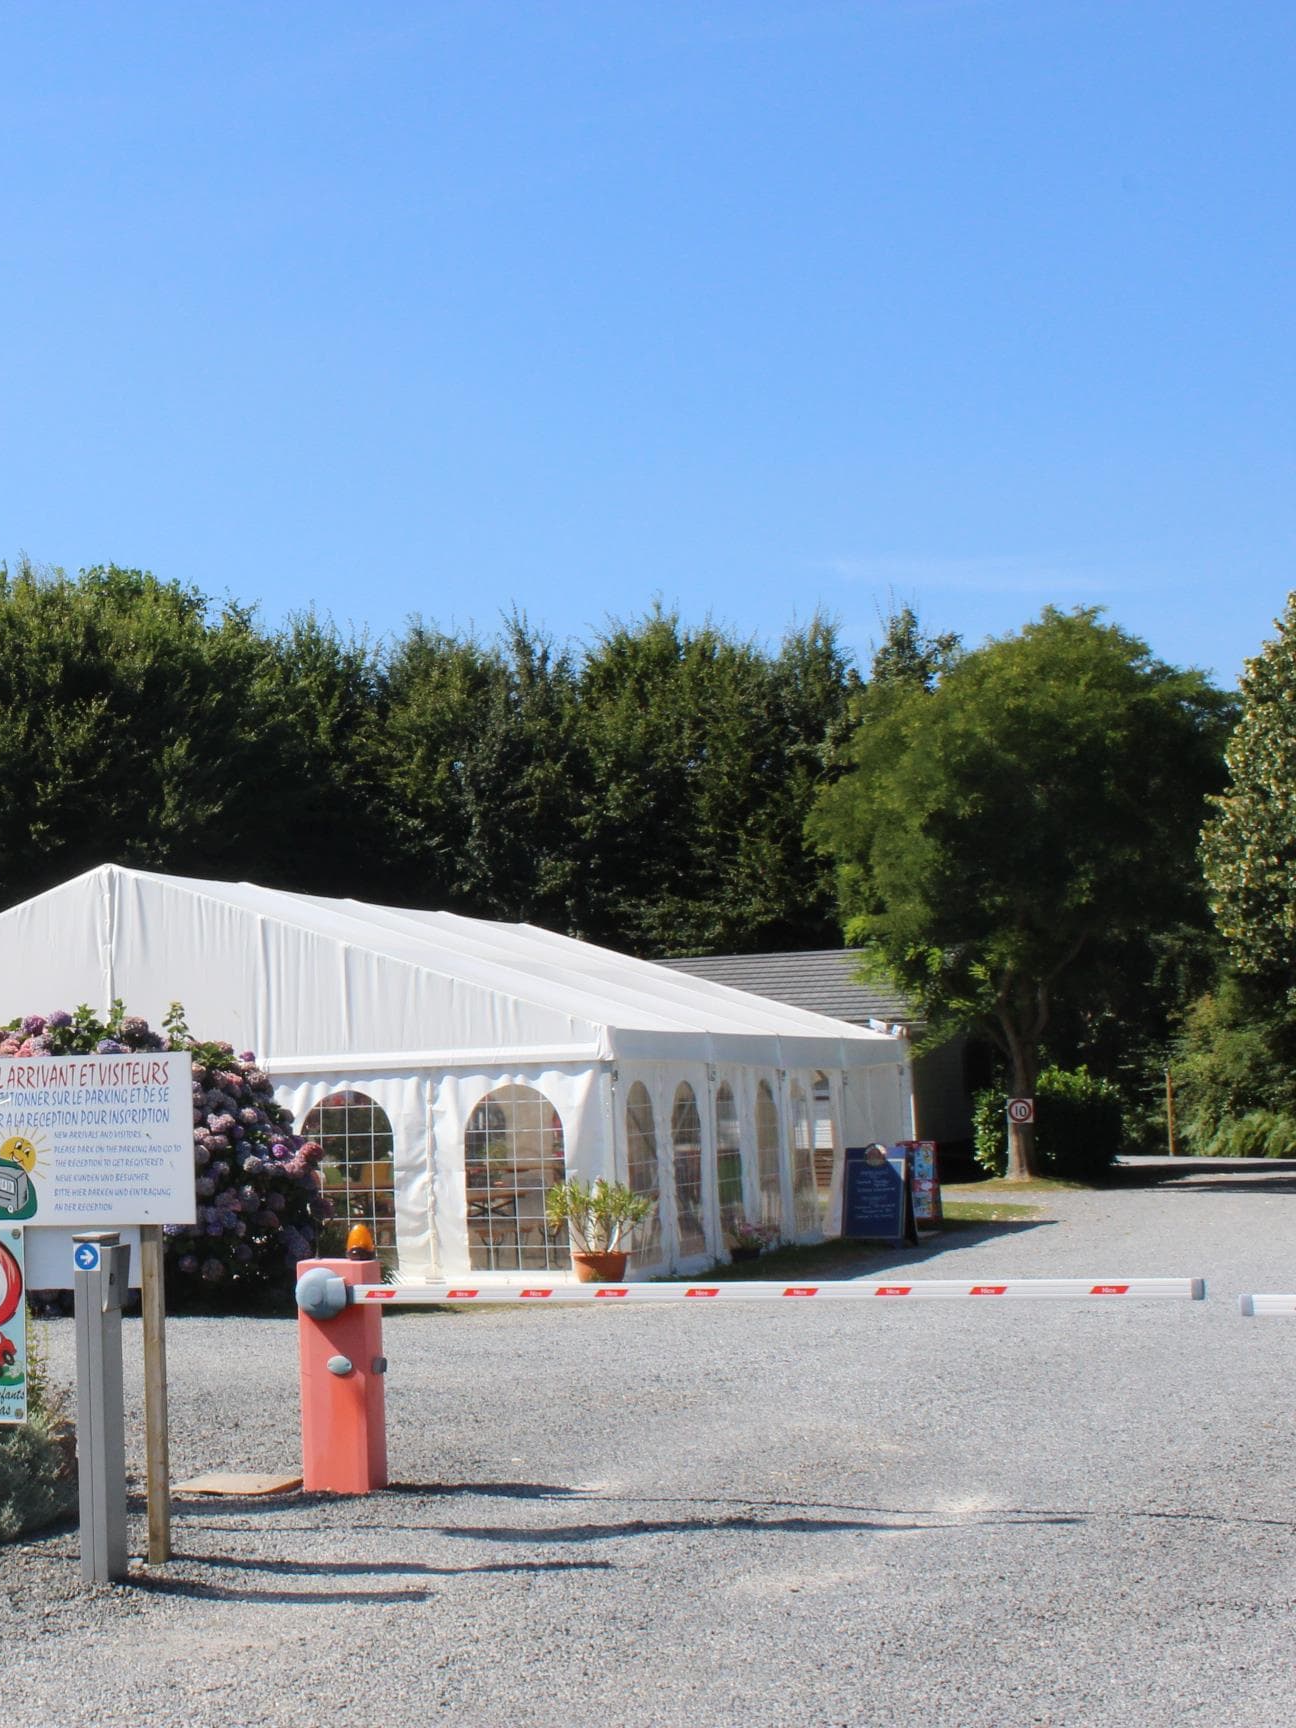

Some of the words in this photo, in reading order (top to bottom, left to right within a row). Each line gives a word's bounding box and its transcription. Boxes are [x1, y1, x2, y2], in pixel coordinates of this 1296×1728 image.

[7, 1064, 76, 1089] ARRIVANT
[80, 1063, 96, 1087] ET
[99, 1061, 169, 1086] VISITEURS
[52, 1090, 70, 1106] SUR
[72, 1090, 82, 1105] LE
[85, 1088, 128, 1106] PARKING
[130, 1087, 141, 1103] ET
[143, 1087, 156, 1103] DE
[158, 1087, 169, 1103] SE
[1015, 1105, 1027, 1117] 10
[7, 1112, 12, 1127] A
[14, 1112, 25, 1127] LA
[27, 1110, 78, 1129] RECEPTION
[81, 1109, 107, 1126] POUR
[109, 1107, 170, 1125] INSCRIPTION
[54, 1130, 67, 1138] NEW
[69, 1130, 98, 1138] ARRIVALS
[100, 1130, 113, 1138] AND
[114, 1130, 142, 1138] VISITORS
[54, 1145, 76, 1153] PLEASE
[77, 1145, 94, 1153] PARK
[95, 1145, 104, 1153] ON
[106, 1145, 117, 1153] THE
[119, 1145, 147, 1153] PARKING
[148, 1144, 162, 1152] AND
[163, 1144, 173, 1153] GO
[174, 1144, 181, 1152] TO
[55, 1159, 66, 1167] THE
[67, 1159, 103, 1167] RECEPTION
[104, 1159, 111, 1167] TO
[112, 1159, 125, 1167] GET
[125, 1158, 164, 1167] REGISTERED
